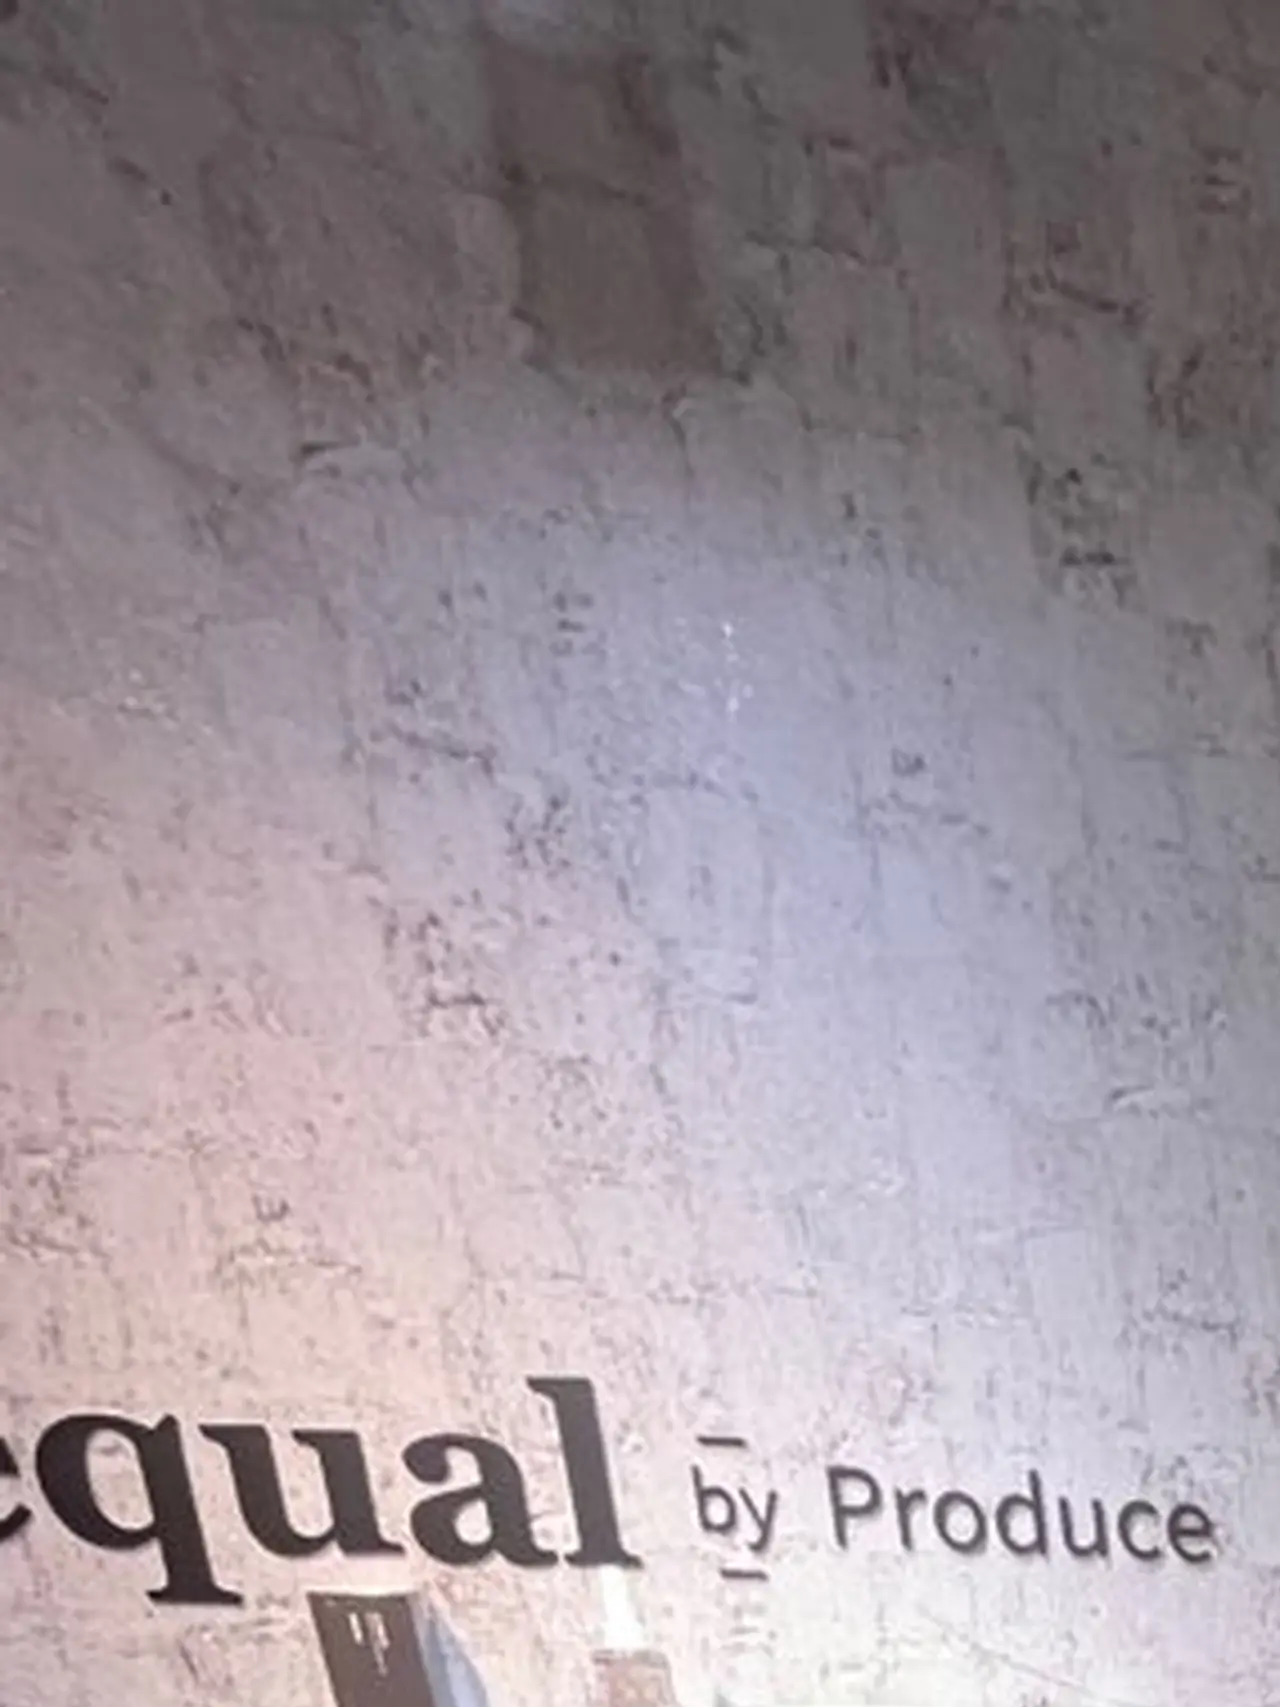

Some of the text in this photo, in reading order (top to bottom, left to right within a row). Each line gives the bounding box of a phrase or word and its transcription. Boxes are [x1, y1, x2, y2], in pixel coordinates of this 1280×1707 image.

[0, 1376, 1215, 1605] qual by Produce
